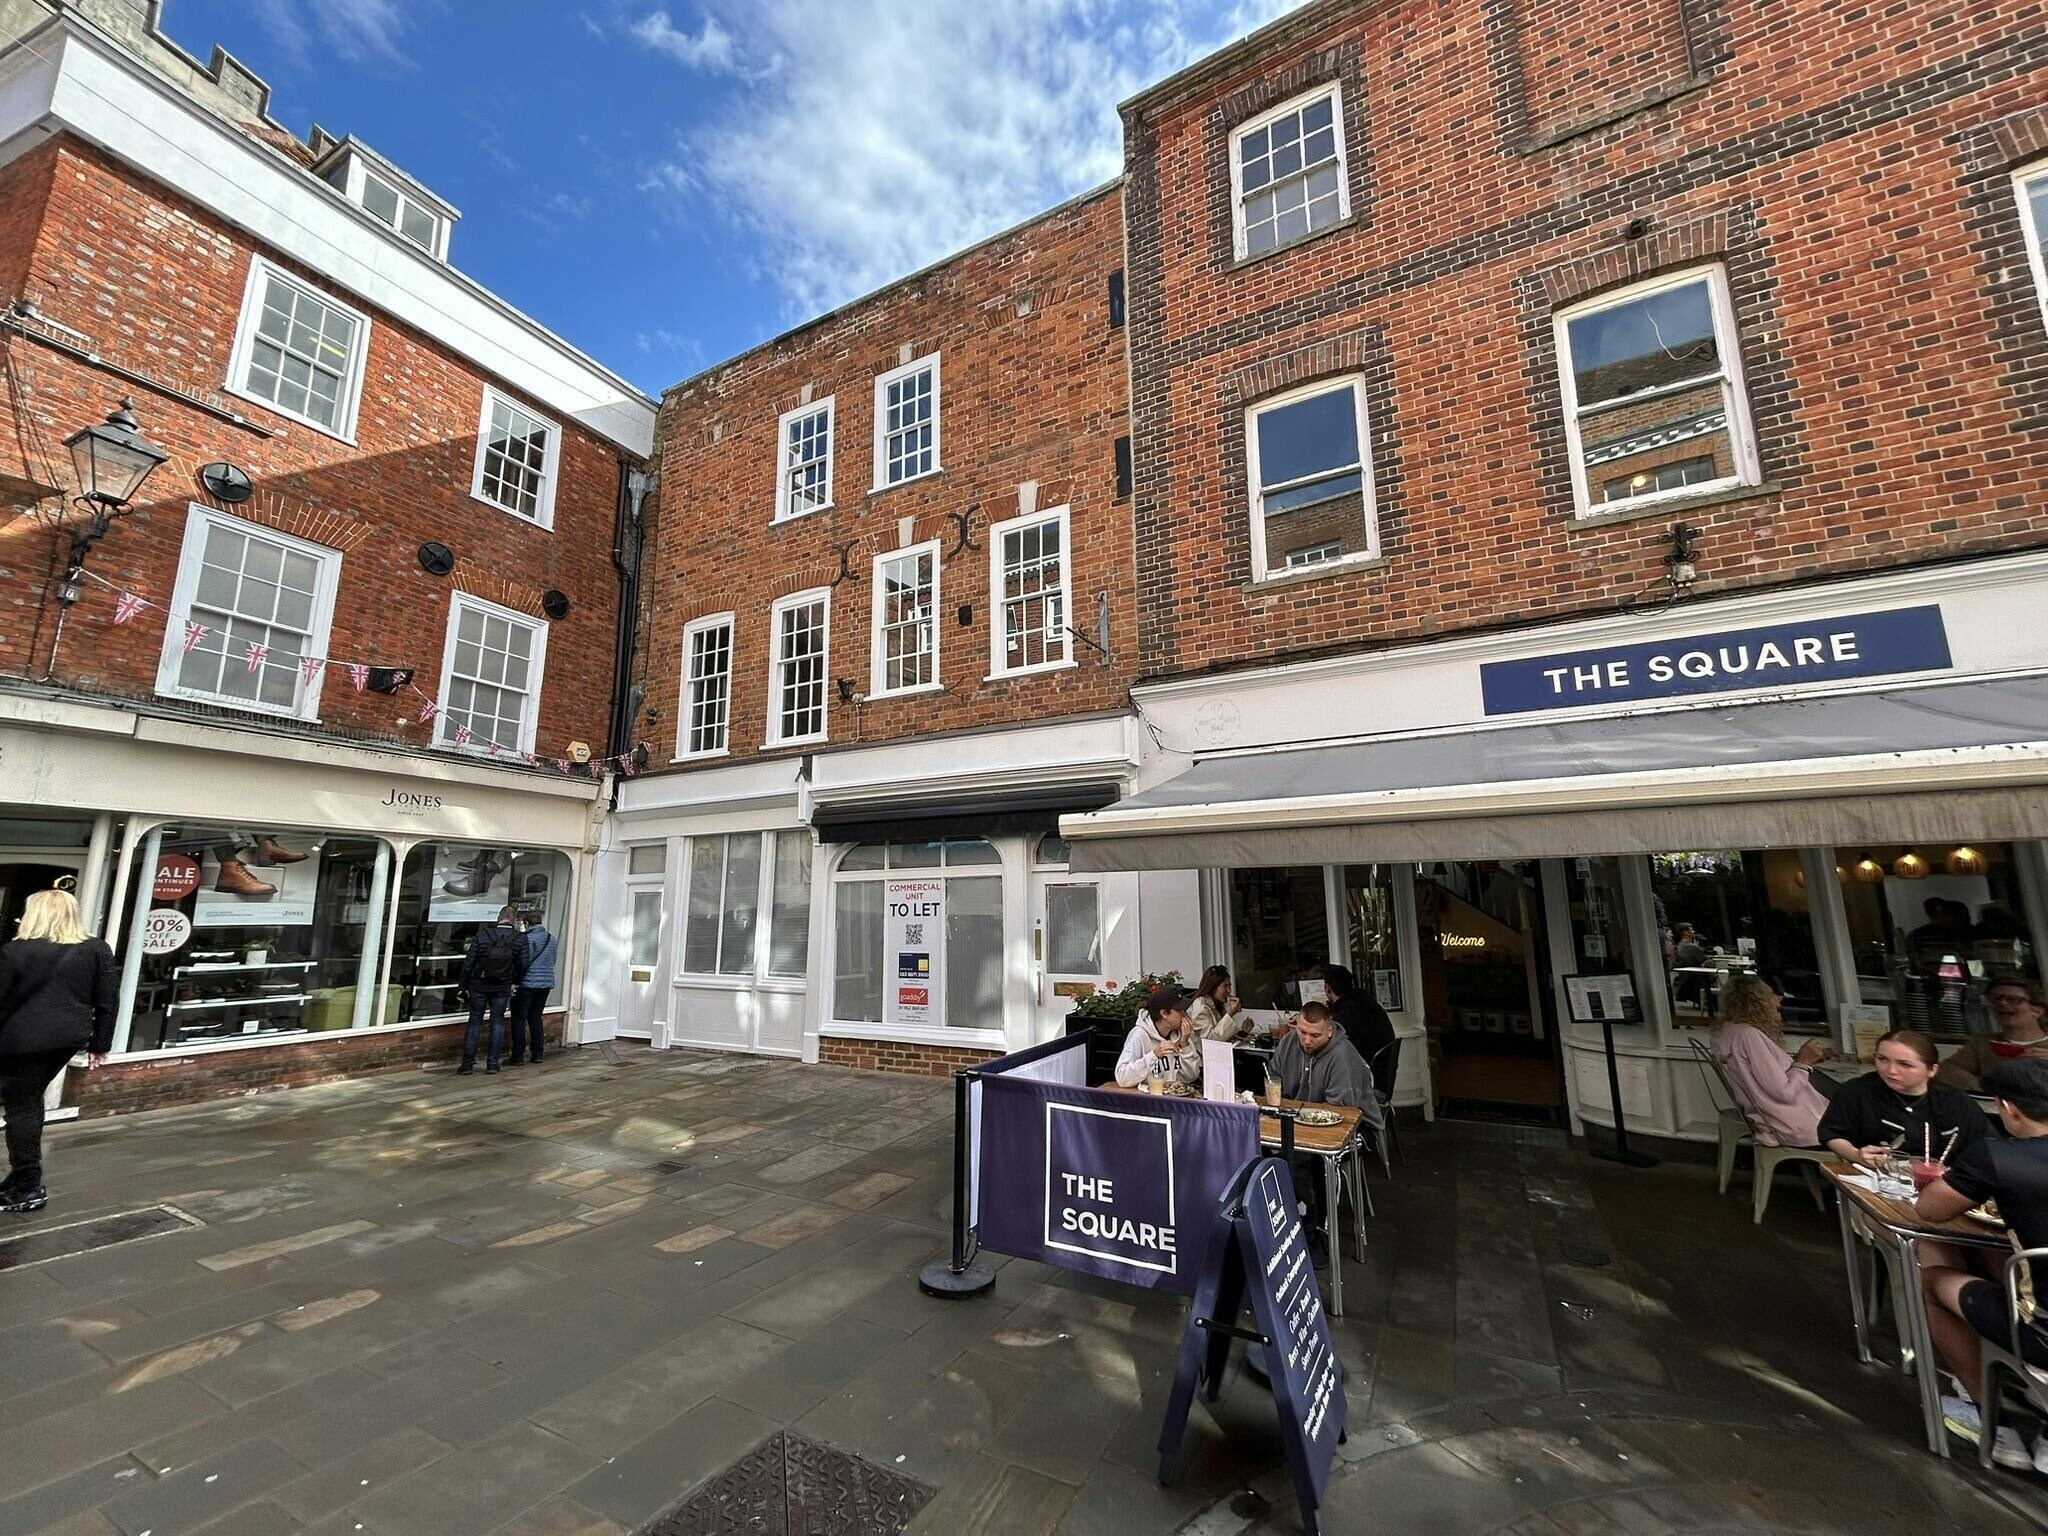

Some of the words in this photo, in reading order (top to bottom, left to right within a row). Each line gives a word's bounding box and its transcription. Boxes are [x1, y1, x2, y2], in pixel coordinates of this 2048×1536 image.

[1543, 660, 1631, 693] THE
[1648, 631, 1860, 683] SQUARE
[157, 866, 196, 879] ALE
[889, 883, 941, 892] COMMERCIAL
[905, 892, 924, 900] UNIT
[889, 903, 909, 917] TO
[913, 902, 941, 917] LET
[1440, 932, 1486, 947] Welcome
[1061, 1172, 1114, 1204] THE
[1061, 1207, 1177, 1253] SQUARE
